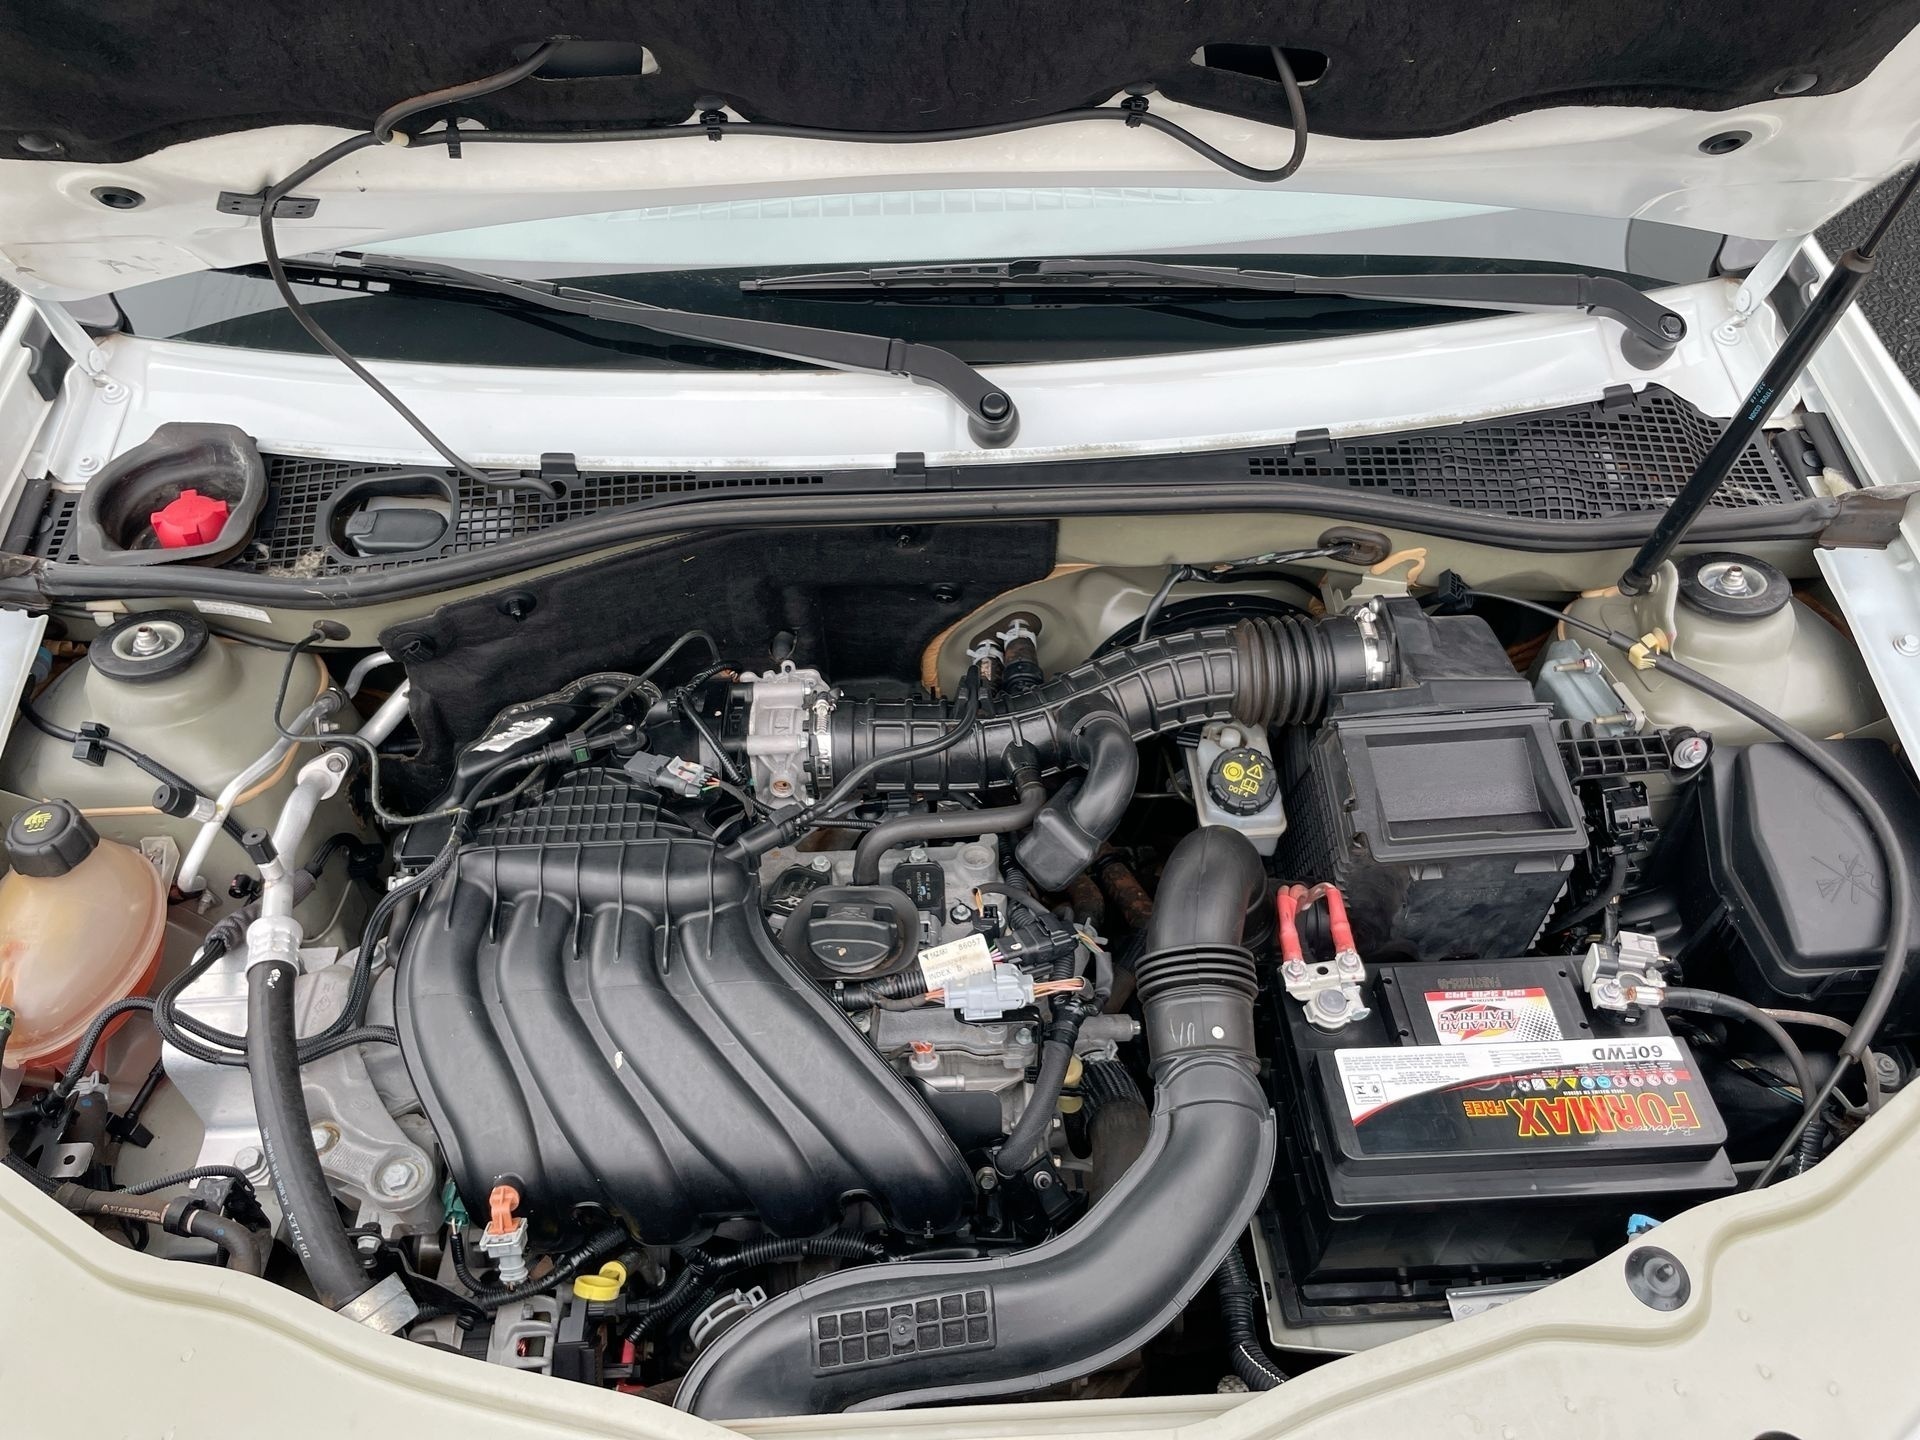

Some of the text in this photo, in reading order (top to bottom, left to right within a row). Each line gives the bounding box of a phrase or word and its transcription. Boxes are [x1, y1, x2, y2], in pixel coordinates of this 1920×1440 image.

[1228, 785, 1242, 795] DOT
[1440, 1011, 1512, 1022] BATERIAS
[1440, 1020, 1518, 1034] ATACADÃO
[1591, 1045, 1663, 1061] 60FWD
[1463, 1091, 1700, 1137] FORMAX FREE
[286, 1212, 304, 1241] FLEX
[299, 1242, 311, 1258] DB
